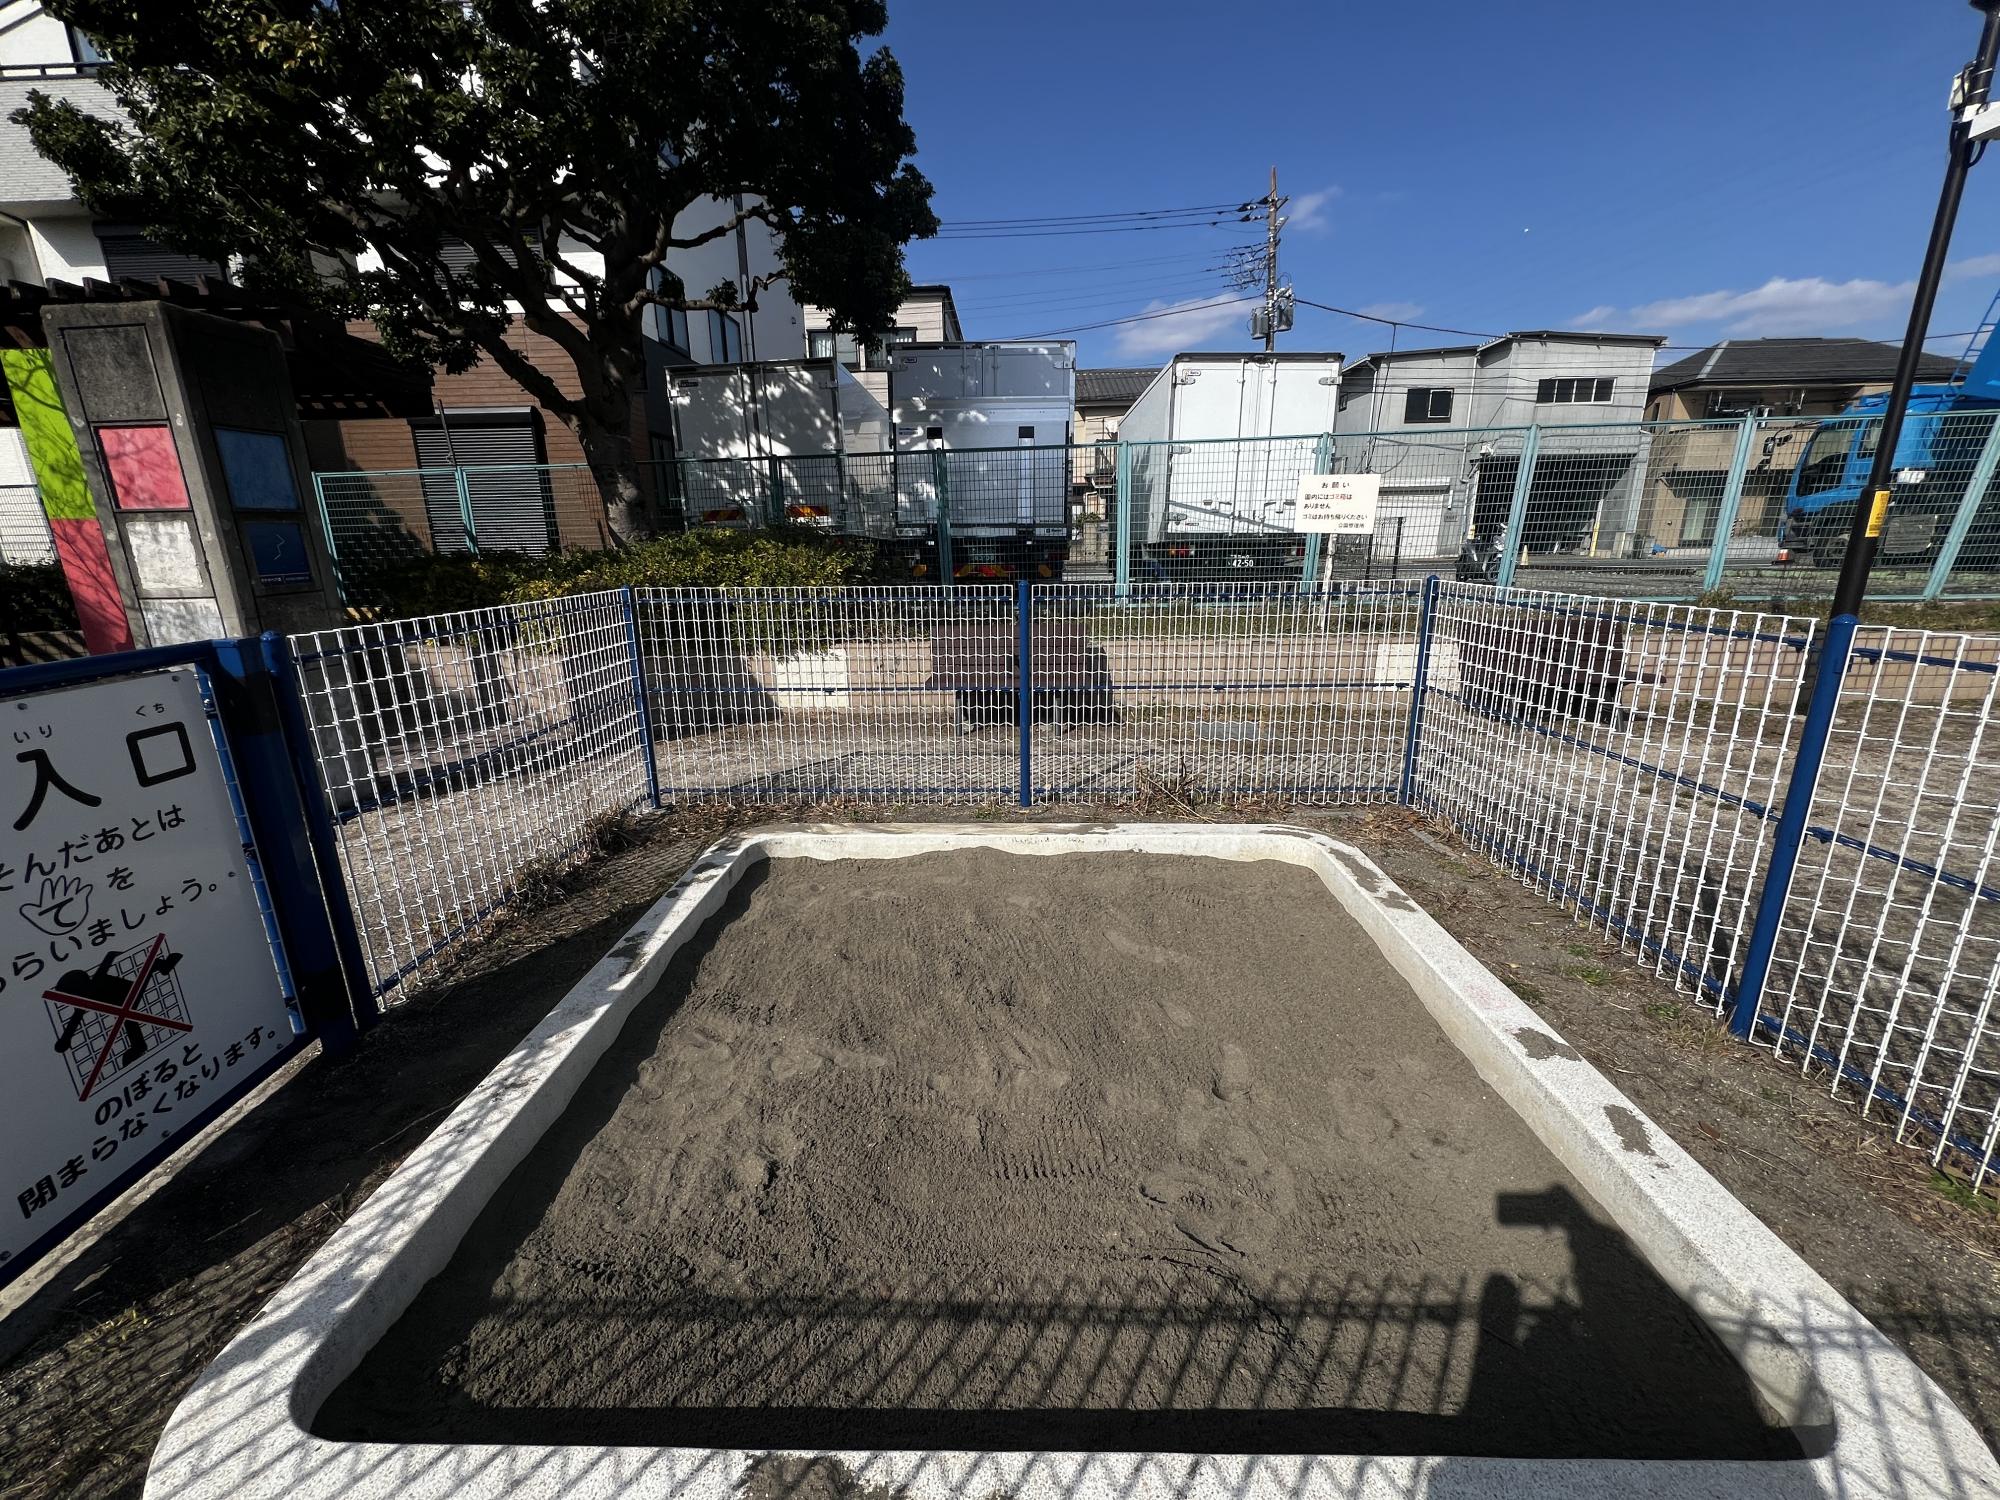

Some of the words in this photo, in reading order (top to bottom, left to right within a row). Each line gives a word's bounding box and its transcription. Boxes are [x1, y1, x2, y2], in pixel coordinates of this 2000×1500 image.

[13, 725, 53, 743] いり
[135, 703, 165, 717] くち
[13, 721, 197, 832] 入口
[107, 867, 135, 891] を
[17, 1026, 277, 1220] 閉まらなくなります。
[94, 1043, 203, 1126] のぼると
